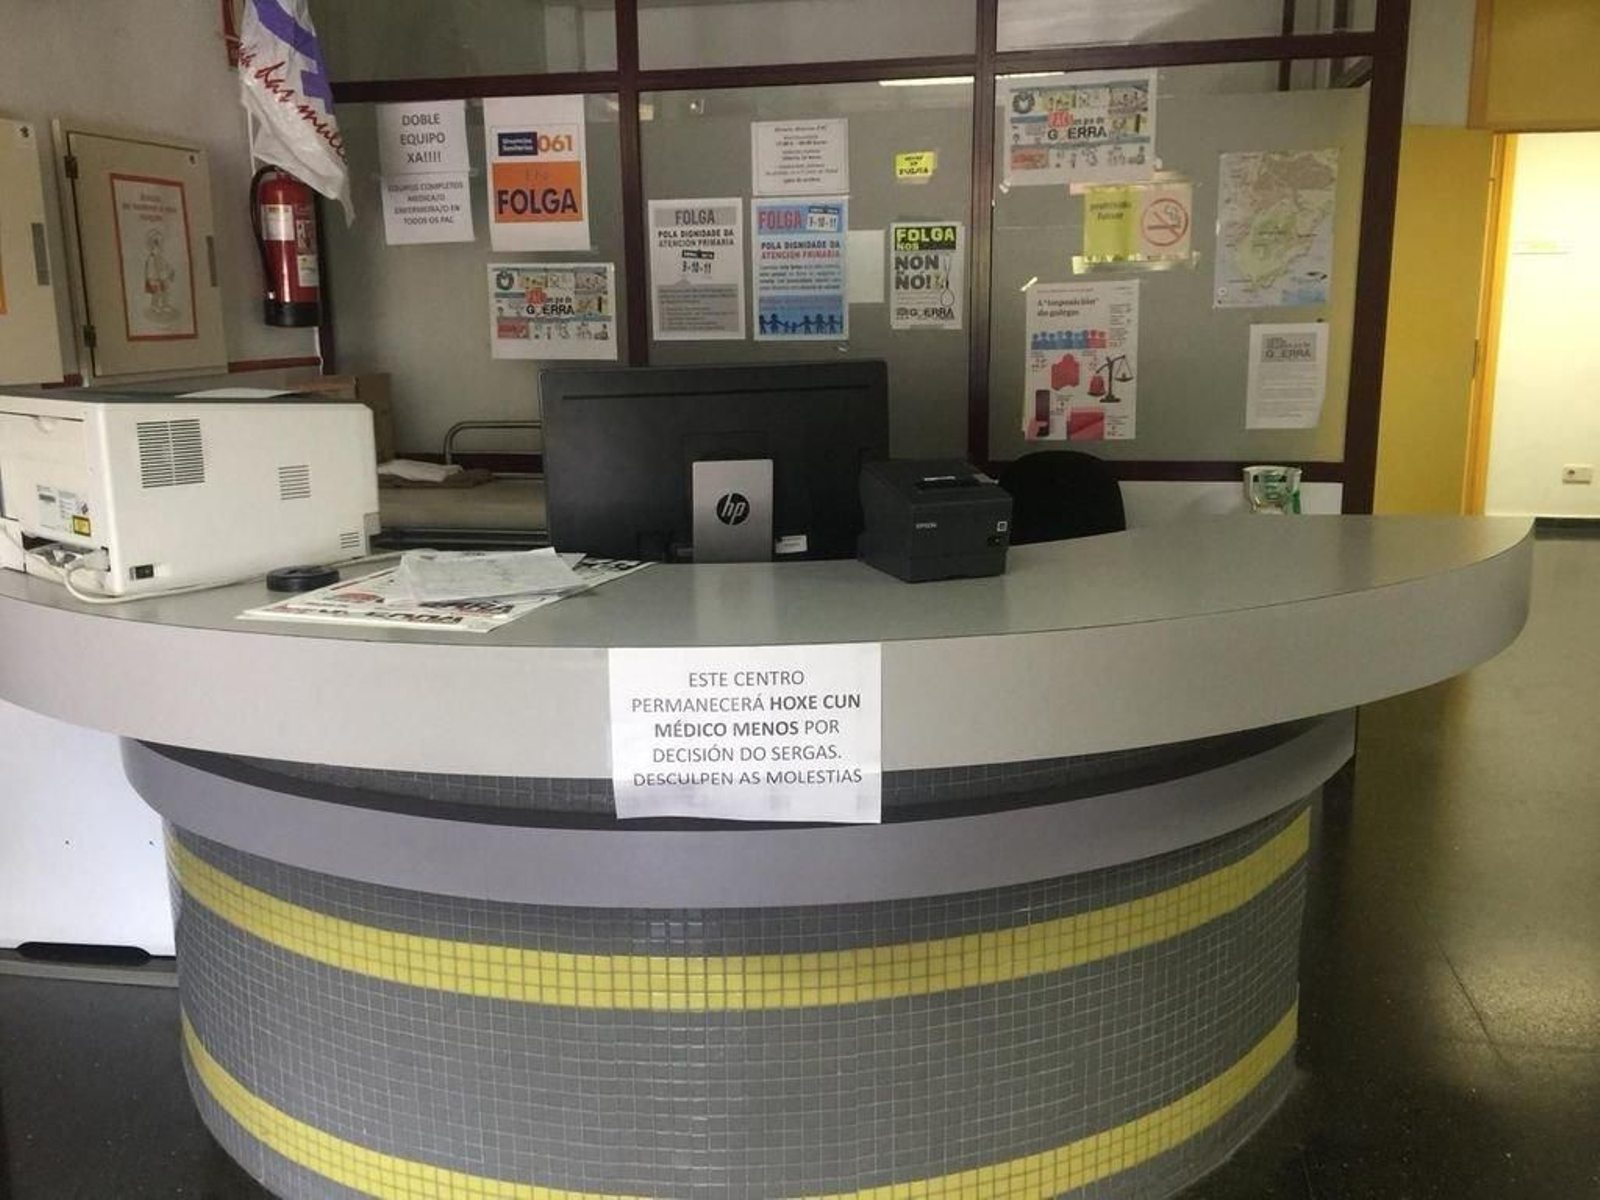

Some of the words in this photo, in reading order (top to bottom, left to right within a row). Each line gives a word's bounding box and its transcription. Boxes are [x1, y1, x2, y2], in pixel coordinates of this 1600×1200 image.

[402, 113, 441, 126] DOBLE
[400, 132, 446, 146] EQUIPO
[538, 135, 574, 152] 061
[406, 151, 442, 163] XA!!!!
[496, 188, 579, 215] FOLGA
[404, 217, 427, 225] TODOS
[428, 216, 440, 224] OS
[675, 208, 716, 226] FOLGA
[758, 208, 802, 231] FOLGA
[658, 229, 679, 238] POLA
[680, 228, 721, 238] DIGNIDADE
[723, 227, 735, 237] DA
[896, 226, 956, 242] FOLGA
[761, 240, 782, 250] POLA
[784, 239, 828, 249] DIGNIDADE
[828, 238, 841, 248] DA
[895, 254, 940, 271] NON
[720, 493, 747, 525] hp
[915, 522, 938, 531] EPSON
[688, 671, 729, 688] ESTE
[733, 670, 805, 687] CENTRO
[631, 692, 765, 713] PERMANECERÁ
[769, 694, 818, 711] HOXE
[822, 693, 861, 710] CUN
[654, 718, 728, 738] MÉDICO
[732, 720, 799, 737] MENOS
[804, 719, 840, 735] POR
[652, 743, 734, 763] DECISIÓN
[739, 746, 767, 761] DO
[771, 744, 842, 761] SERGAS.
[633, 772, 734, 787] DESCULPEN
[739, 771, 761, 785] AS
[766, 768, 863, 785] MOLESTIAS
